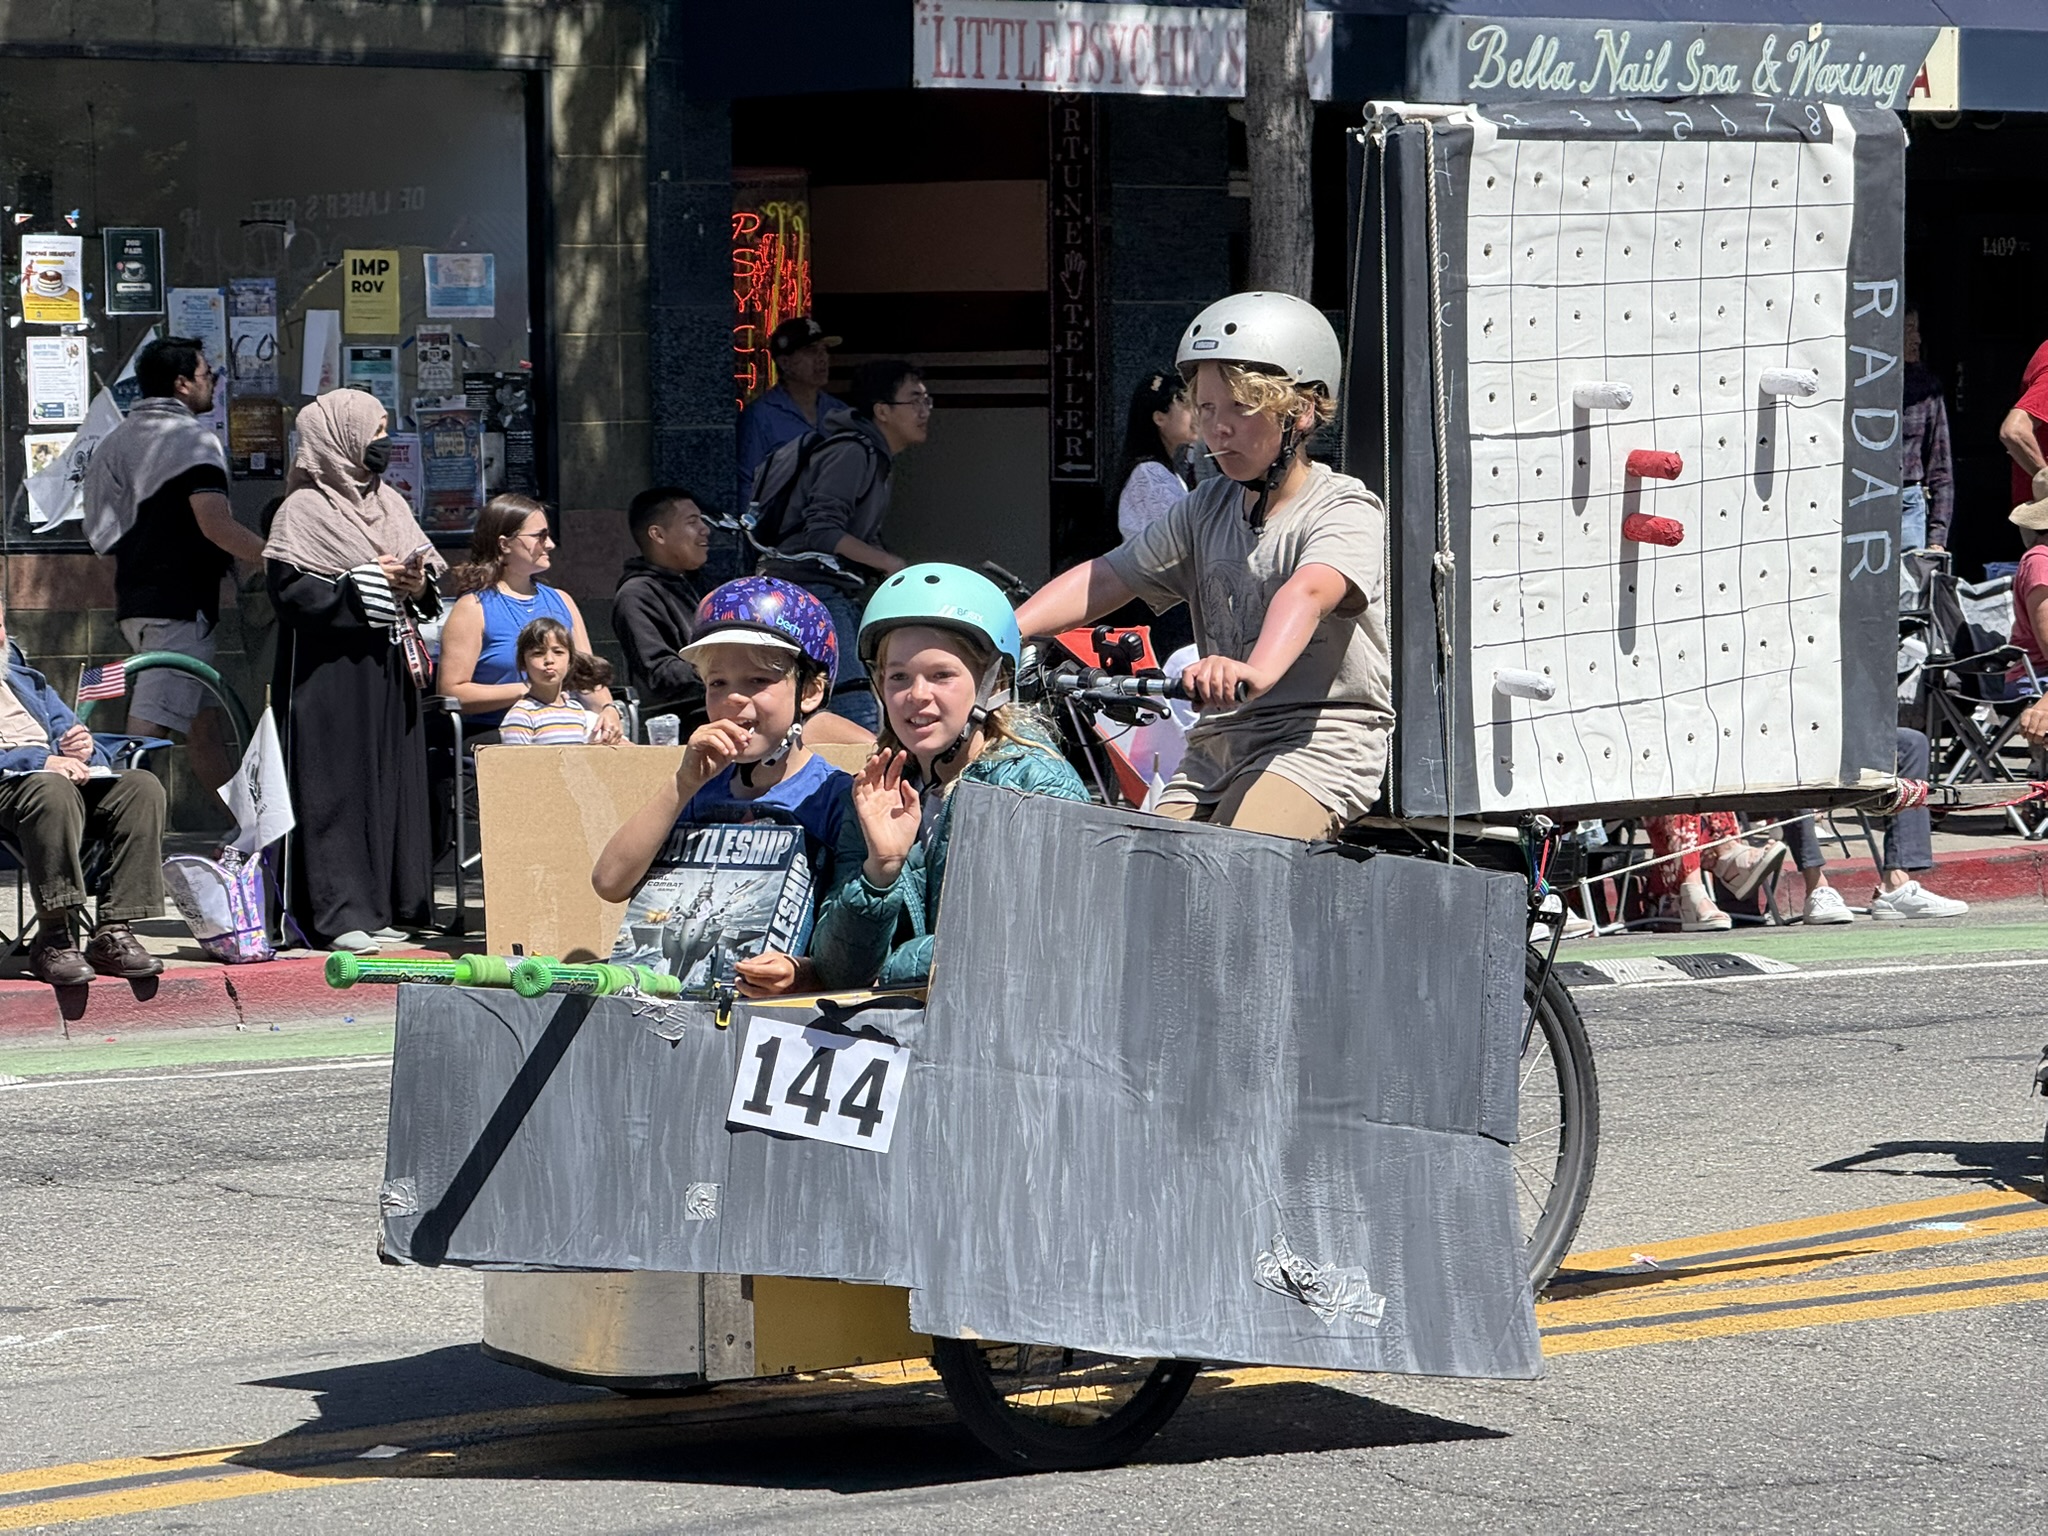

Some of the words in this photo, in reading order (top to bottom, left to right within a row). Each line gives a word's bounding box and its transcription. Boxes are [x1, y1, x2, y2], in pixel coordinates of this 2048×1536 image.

[932, 15, 1058, 82] LITTLE
[1067, 20, 1215, 89] PSYCHIC
[1467, 25, 1576, 89] Bella
[1579, 29, 1669, 93] Nail
[1677, 39, 1741, 95] Spa
[1752, 33, 1781, 95] &
[1787, 38, 1905, 109] Waxing
[1570, 110, 1592, 128] 3
[1616, 110, 1641, 133] 4
[1710, 105, 1737, 137] 6
[1755, 103, 1775, 132] 7
[1804, 105, 1822, 136] 8
[1062, 93, 1082, 244] RTUNE
[351, 258, 389, 276] IMP
[351, 280, 385, 293] ROV
[732, 212, 760, 412] PSYCH
[1063, 304, 1083, 457] TELLER
[1844, 278, 1899, 580] RADAR
[647, 880, 684, 888] COMBAT
[660, 827, 794, 865] ATTLESHIP
[742, 1035, 890, 1138] 144
